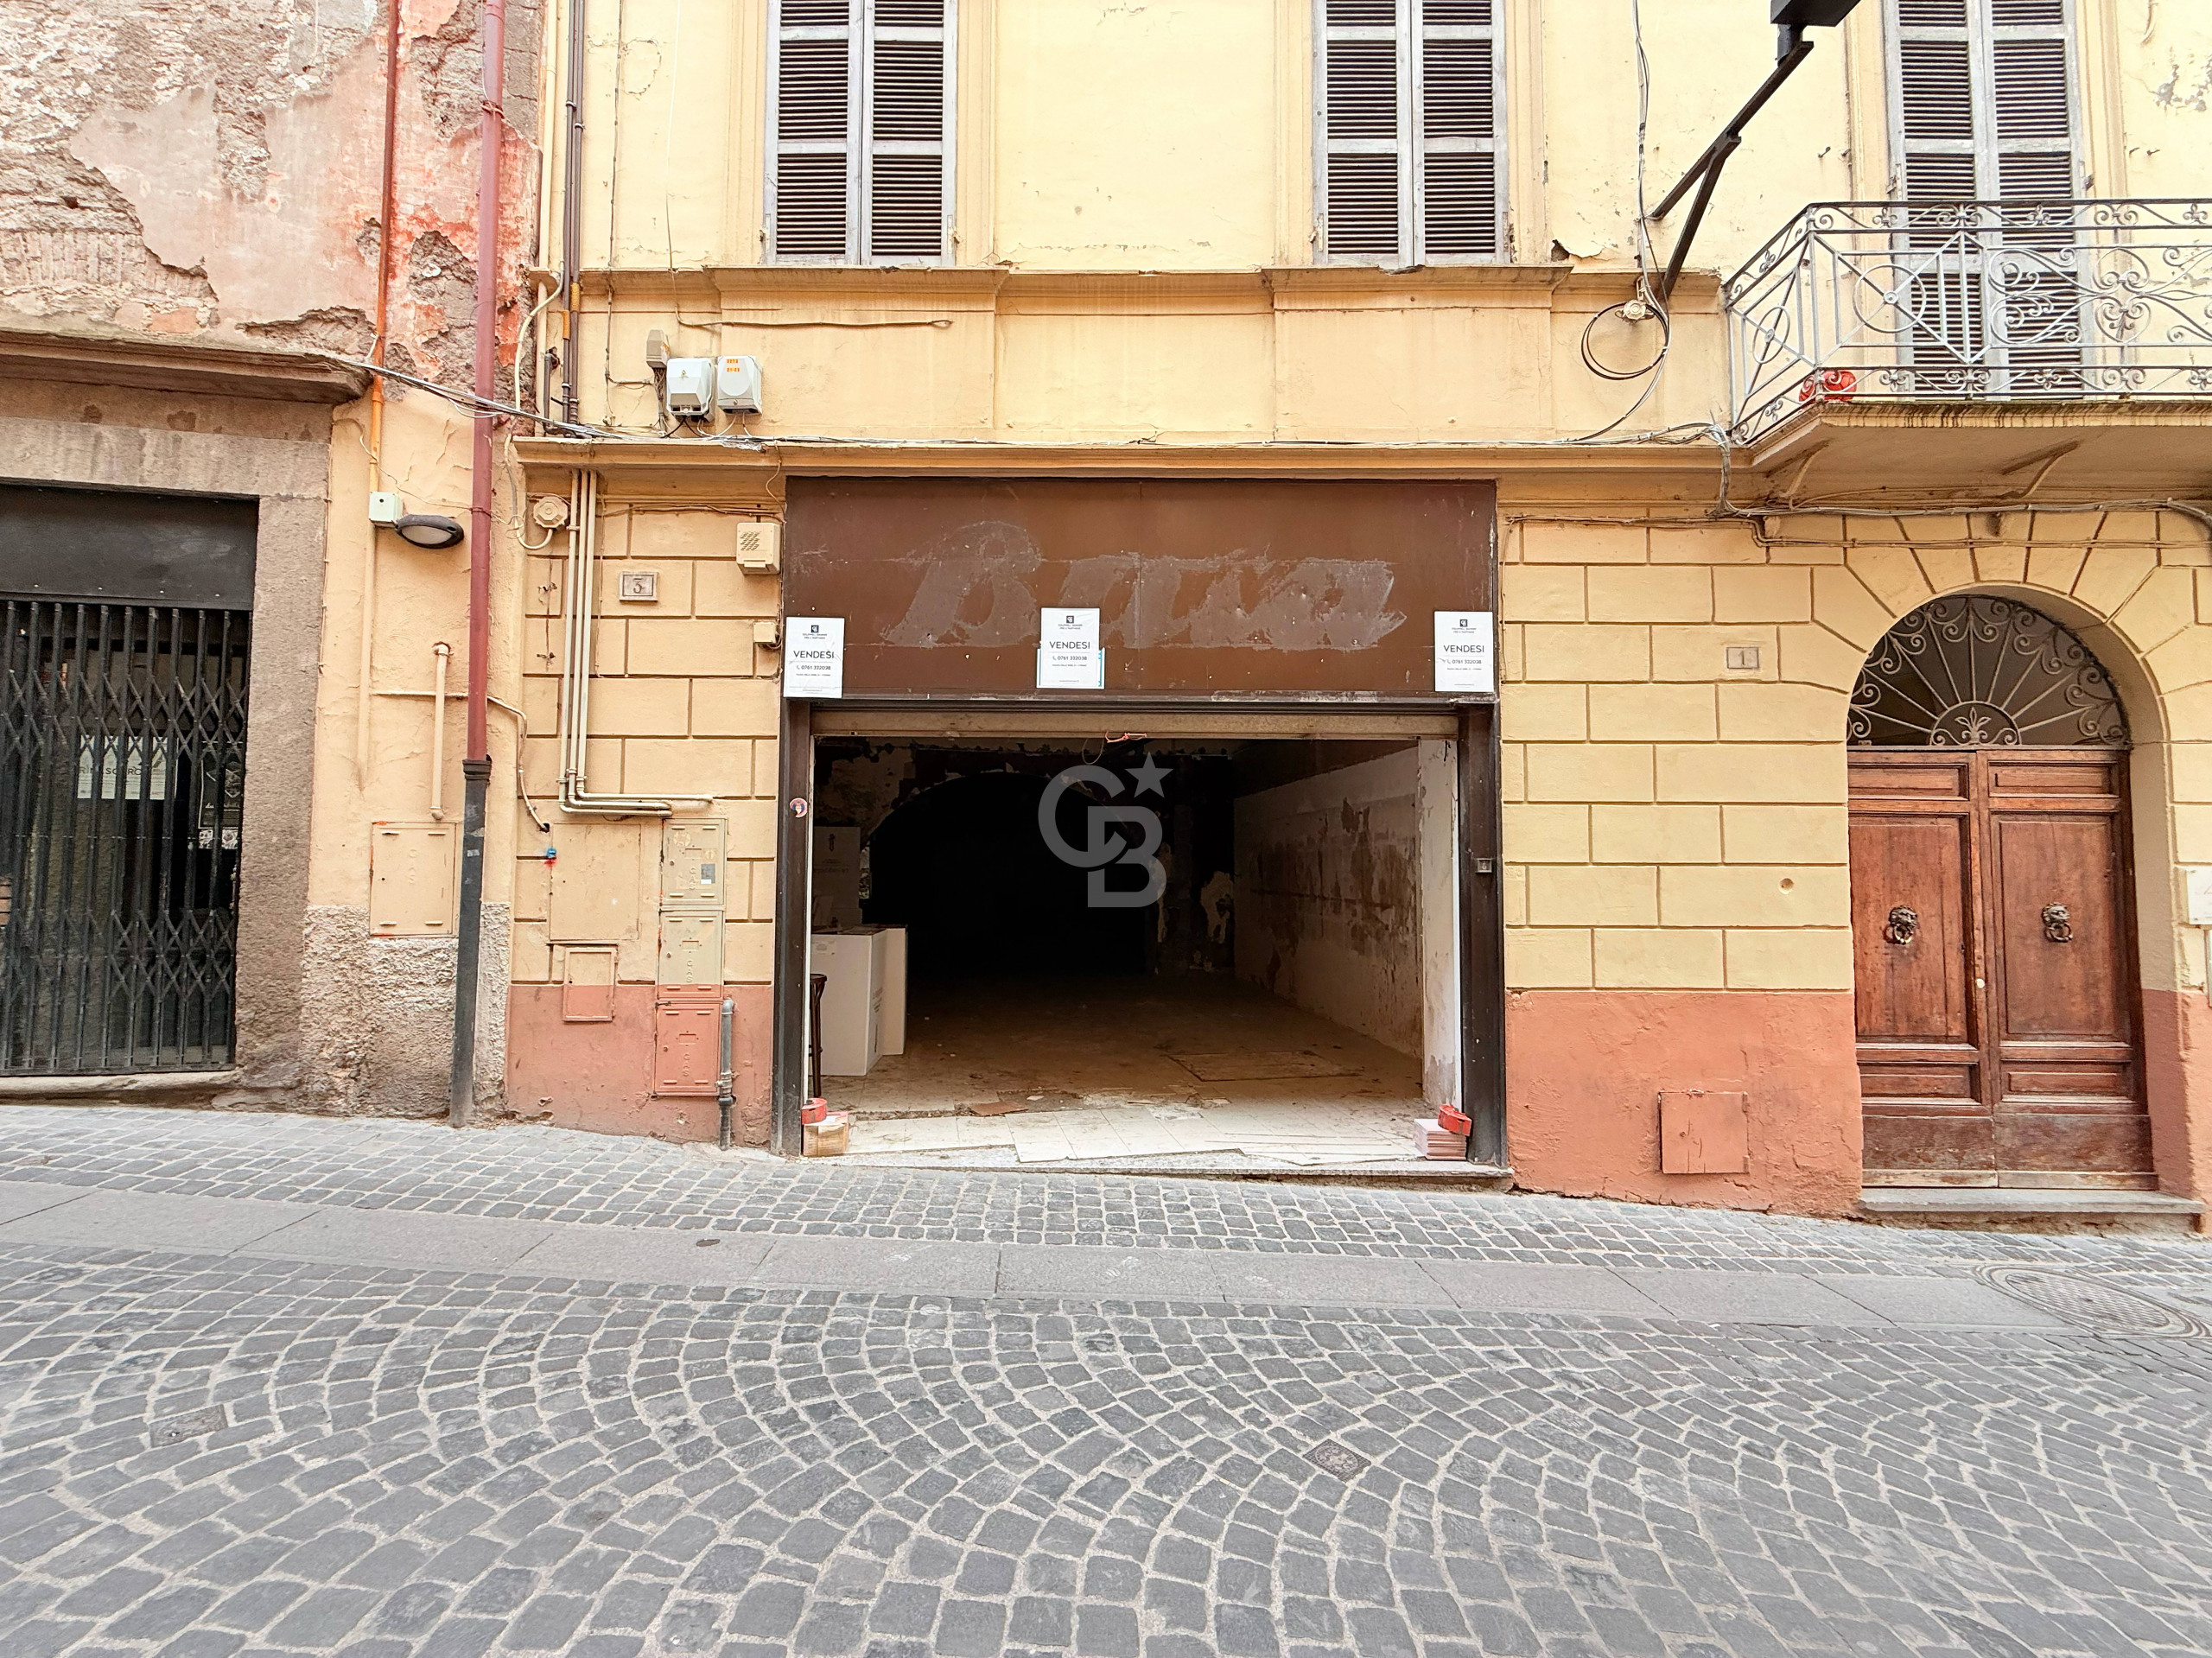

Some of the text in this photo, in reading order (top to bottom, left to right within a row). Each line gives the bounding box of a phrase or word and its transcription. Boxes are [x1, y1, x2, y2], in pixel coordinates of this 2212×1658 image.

[632, 577, 643, 594] 3
[793, 651, 835, 659] VENDESI
[1443, 645, 1484, 653] VENDESI
[1738, 651, 1745, 665] 1
[684, 959, 695, 983] GAS
[681, 1053, 691, 1077] GAS
